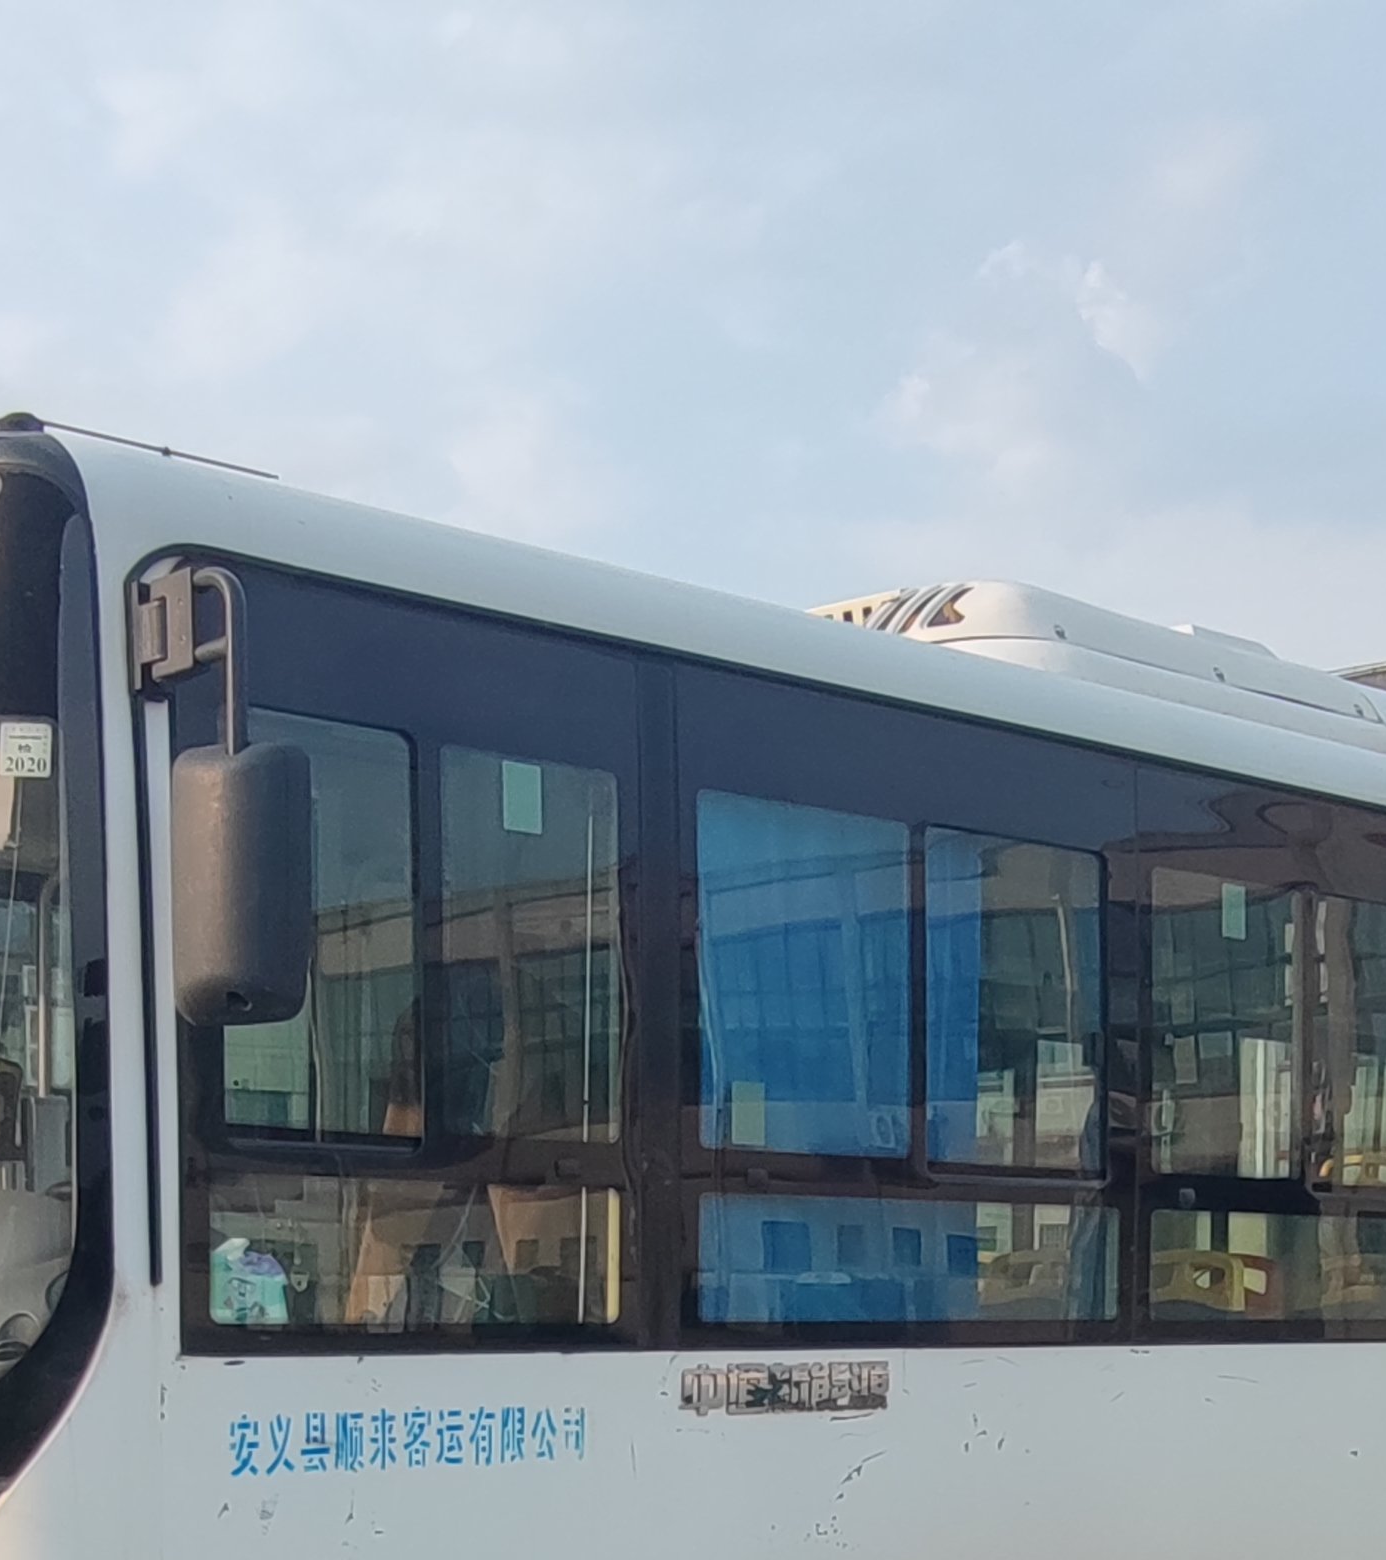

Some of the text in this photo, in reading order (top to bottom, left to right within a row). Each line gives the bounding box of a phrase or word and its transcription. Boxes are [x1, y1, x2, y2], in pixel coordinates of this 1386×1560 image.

[4, 756, 47, 773] 2020
[229, 1405, 586, 1477] 安义县顺来客运有限公司
